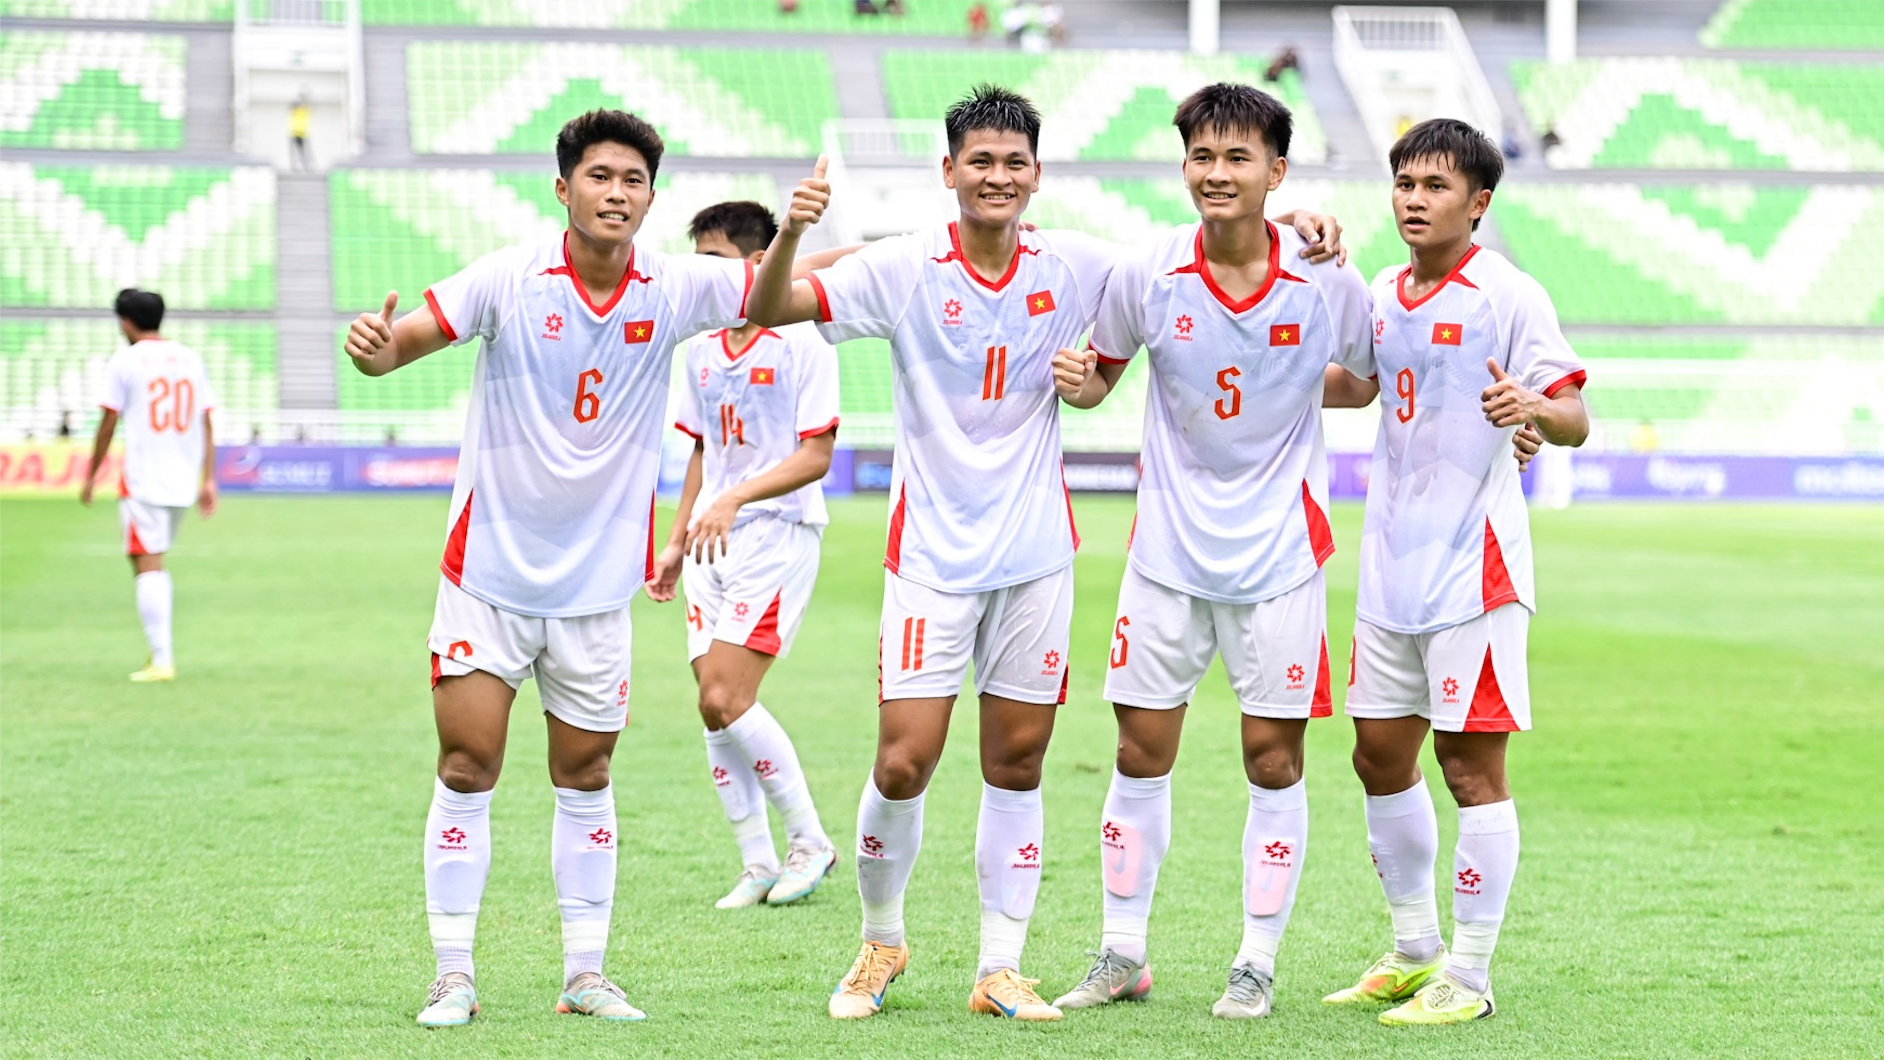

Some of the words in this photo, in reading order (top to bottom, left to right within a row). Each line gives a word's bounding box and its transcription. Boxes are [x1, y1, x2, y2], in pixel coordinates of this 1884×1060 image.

[573, 368, 604, 424] 6
[982, 345, 1007, 401] 11
[1214, 366, 1242, 421] 5
[1396, 367, 1415, 424] 9
[148, 376, 195, 434] 20
[720, 403, 745, 448] 14
[901, 616, 926, 672] 11
[1109, 615, 1131, 670] 5
